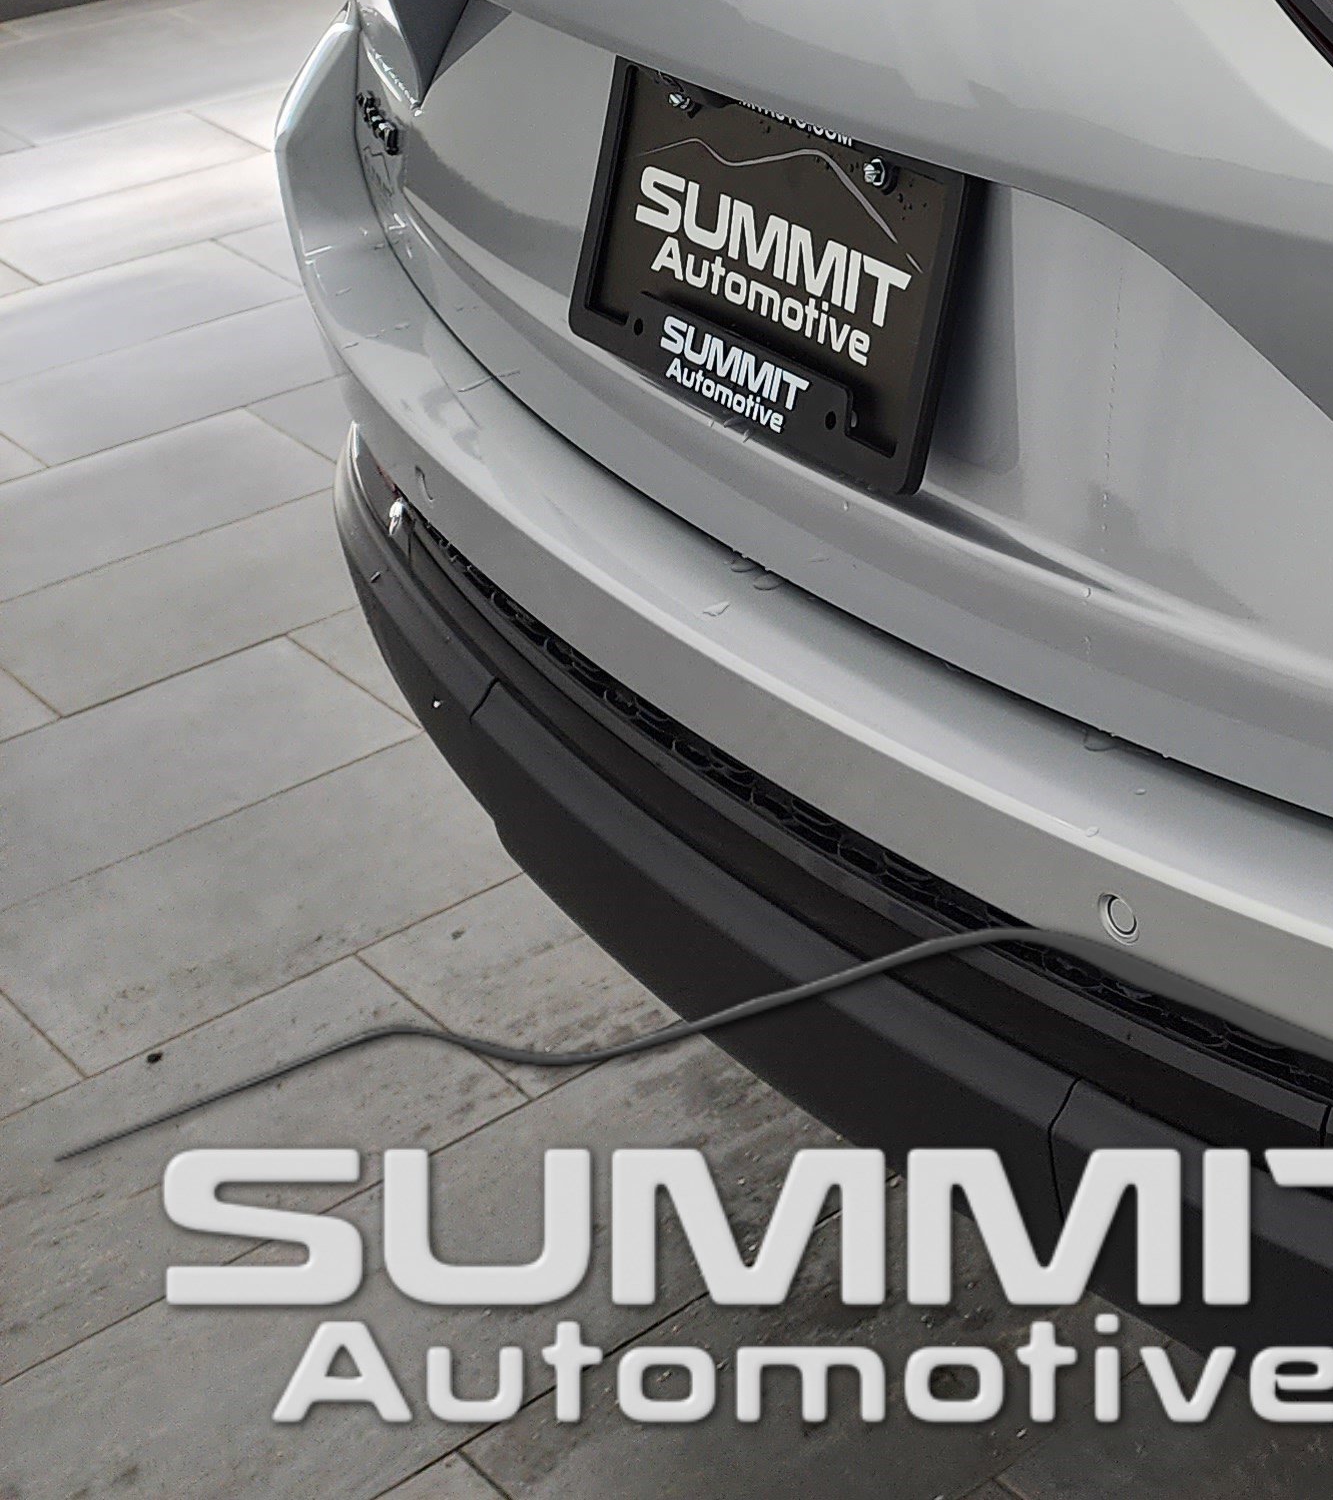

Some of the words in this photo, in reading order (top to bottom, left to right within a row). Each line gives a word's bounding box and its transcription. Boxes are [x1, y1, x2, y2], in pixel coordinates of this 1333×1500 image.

[635, 166, 912, 328] SUMMIT
[650, 236, 871, 367] Automotive
[660, 315, 810, 412] SUMMIT
[665, 358, 785, 435] Automotive
